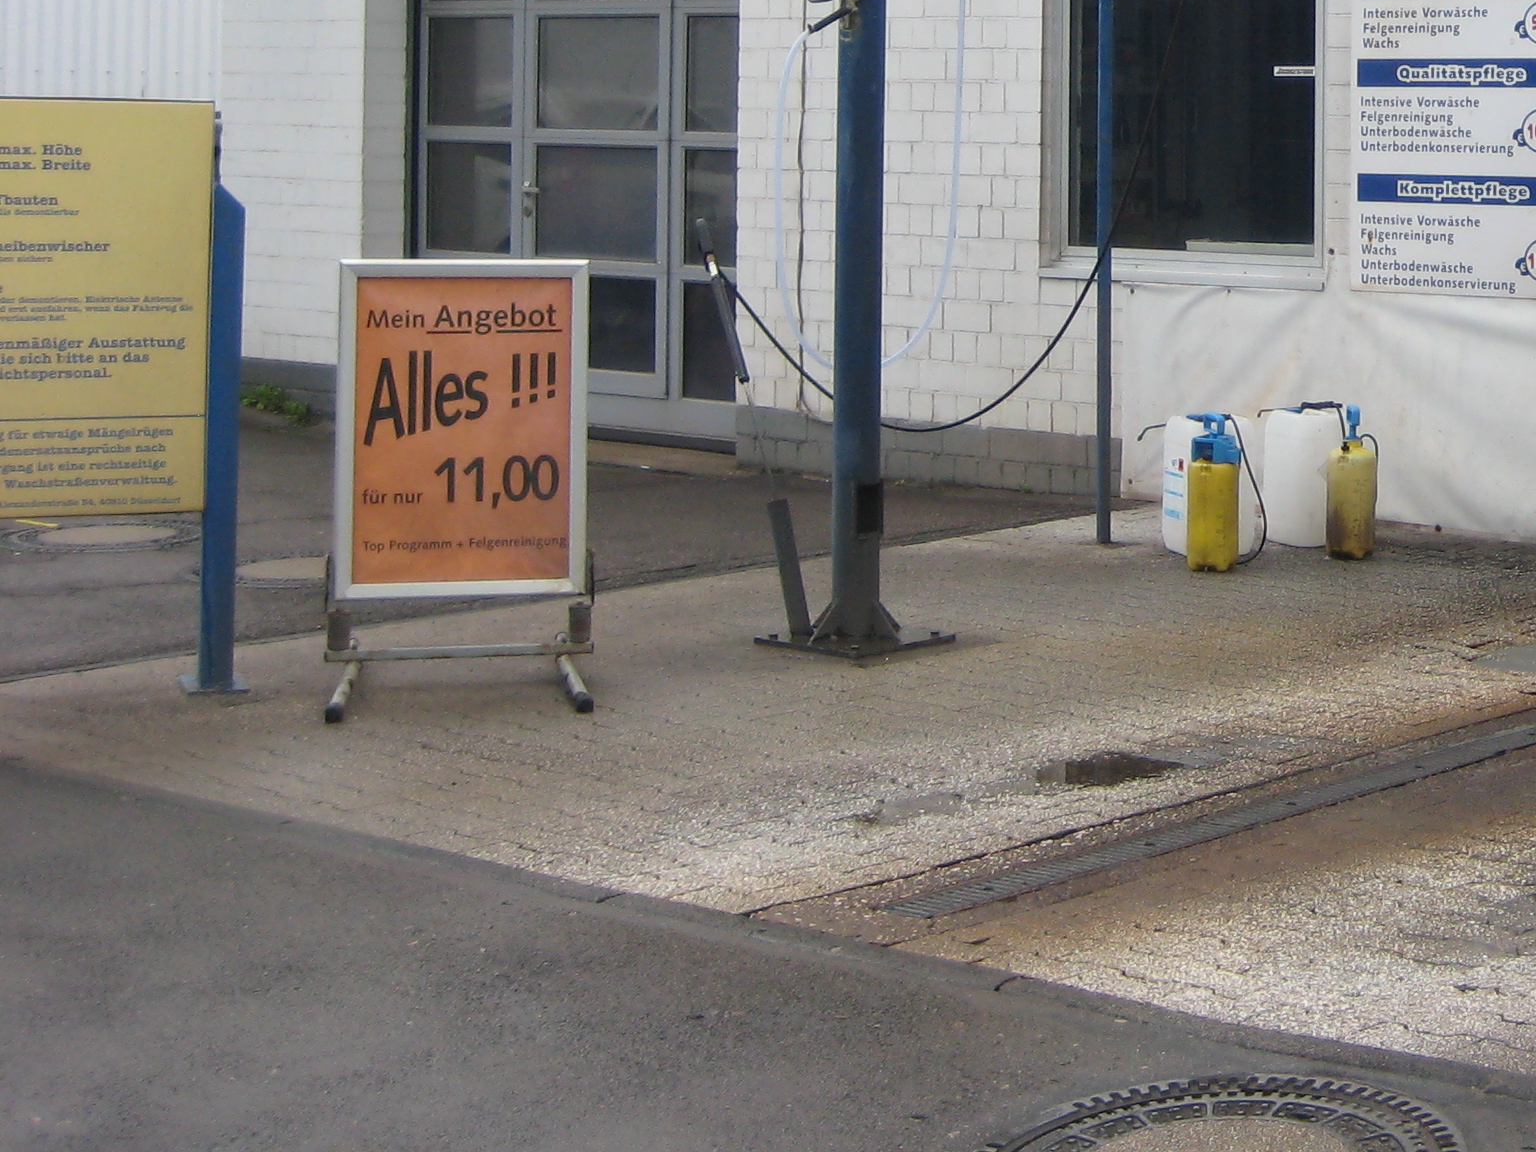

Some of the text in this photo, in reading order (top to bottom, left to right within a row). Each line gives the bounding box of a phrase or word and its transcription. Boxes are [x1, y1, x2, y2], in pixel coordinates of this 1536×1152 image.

[1363, 6, 1488, 19] Intensive Vorwäsche
[1363, 23, 1460, 36] Felgenreinigung
[1363, 38, 1399, 48] Wachs
[1399, 66, 1525, 84] Qualitätspflege
[1361, 96, 1480, 108] Intensive Vorwäsche
[1361, 111, 1453, 126] Felgenreinigung
[1361, 126, 1472, 138] Unterbodenwäsche
[42, 143, 83, 156] Höhe
[1361, 141, 1514, 157] Unterbodenkonservierung
[42, 159, 91, 170] Breite
[1399, 182, 1528, 202] Komplettpflege
[1361, 214, 1481, 227] Intensive Vorwäsche
[1361, 228, 1454, 244] Felgenreinigung
[1361, 244, 1397, 256] Wachs
[1361, 259, 1473, 274] Unterbodenwäsche
[1361, 274, 1516, 294] Unterbodenkonservierung
[366, 302, 557, 335] Mein Angebot
[88, 337, 187, 350] Ausstattung
[18, 352, 51, 364] sich
[56, 352, 94, 364] bitte
[99, 354, 118, 363] an
[122, 352, 150, 363] das
[363, 350, 556, 447] Alles !!!
[8, 430, 30, 439] für
[33, 429, 84, 440] etwaige
[88, 427, 174, 439] Mängelrügen
[135, 443, 166, 453] nach
[0, 458, 167, 475] gang ist eine rechtzeitige
[4, 475, 178, 489] Waschstraßenverwaltung.
[362, 455, 559, 510] für nur 11,00
[363, 535, 567, 554] Top Programm + Felgenreinigung
